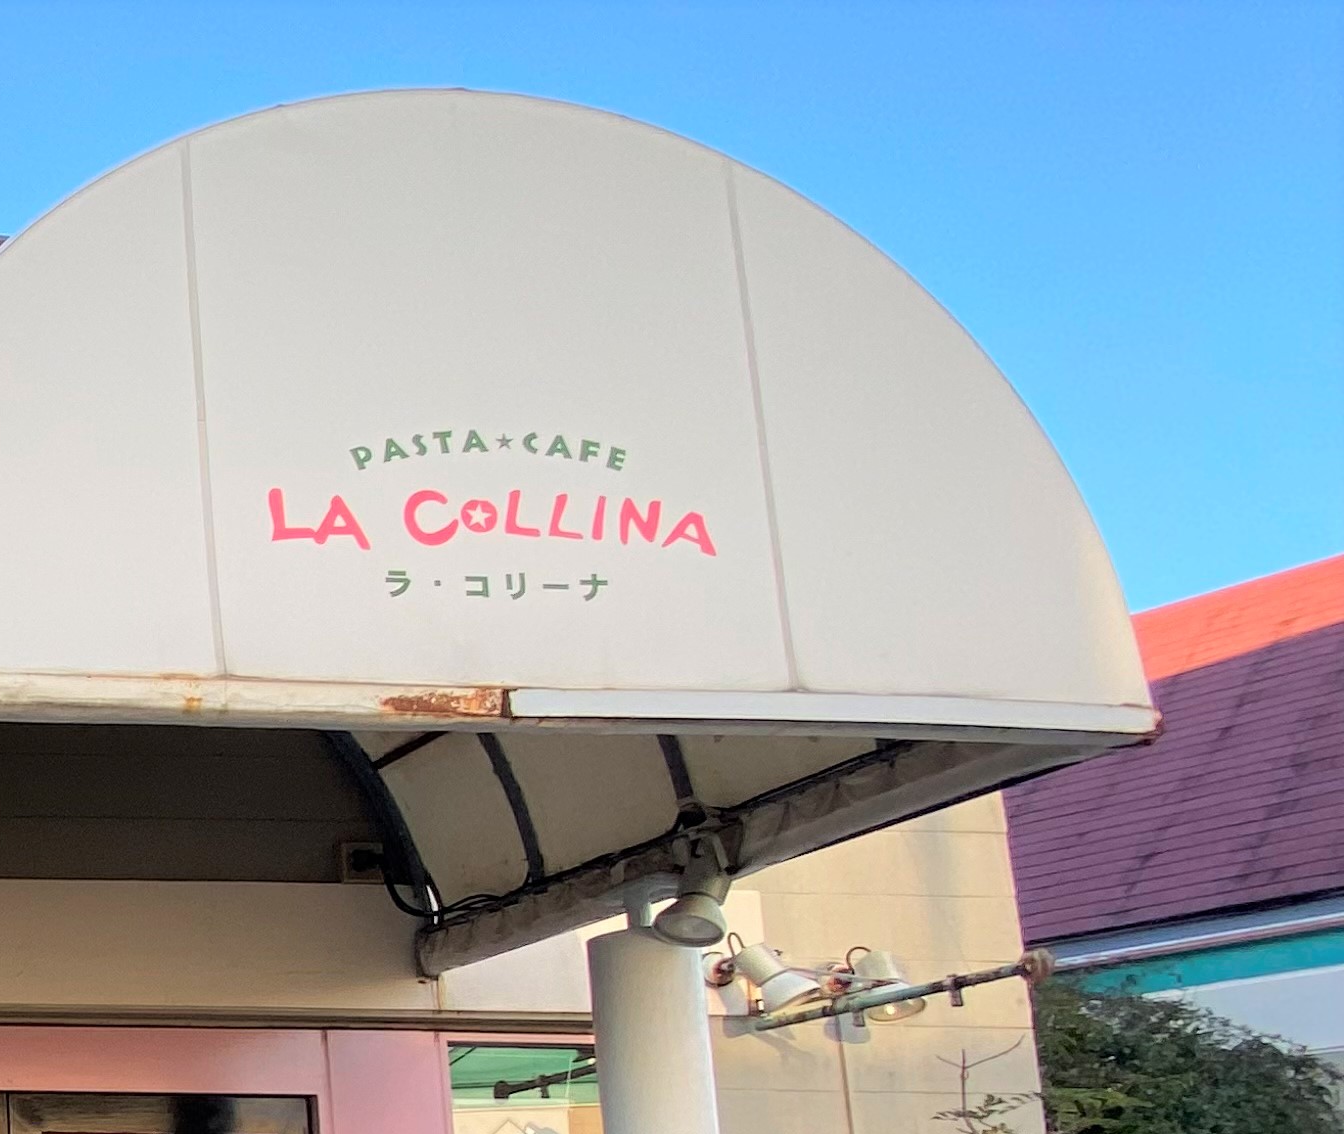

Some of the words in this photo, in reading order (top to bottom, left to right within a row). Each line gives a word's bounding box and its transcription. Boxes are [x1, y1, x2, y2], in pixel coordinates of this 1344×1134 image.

[348, 428, 491, 471] PASTA
[521, 431, 628, 473] CAFE
[267, 487, 372, 552] LA
[385, 569, 609, 601] ラ・コリーナ
